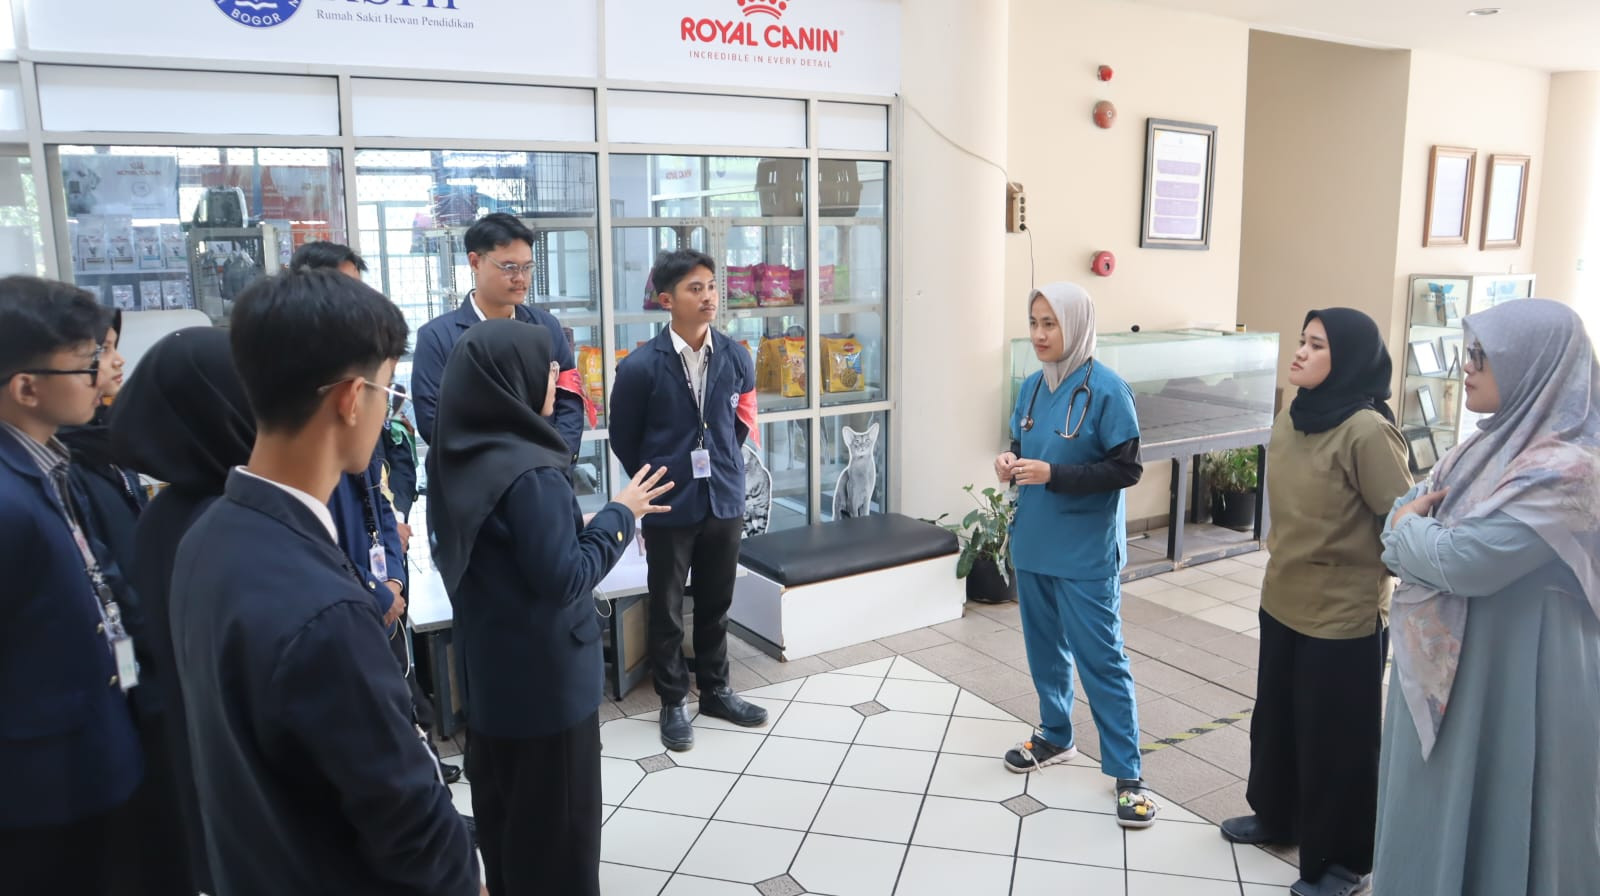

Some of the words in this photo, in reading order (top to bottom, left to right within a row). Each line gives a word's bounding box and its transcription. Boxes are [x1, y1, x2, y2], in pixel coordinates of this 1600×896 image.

[231, 8, 282, 25] BOGOR
[316, 9, 353, 22] Rumah
[356, 12, 381, 24] Sakit
[384, 14, 419, 26] Hewan
[421, 16, 474, 30] Pendidikan
[680, 16, 759, 47] ROYAL
[763, 24, 838, 53] CANIN
[689, 50, 750, 63] INCREDIBLE
[753, 56, 764, 64] IN
[767, 57, 797, 66] EVERY
[800, 58, 832, 69] DETAIL
